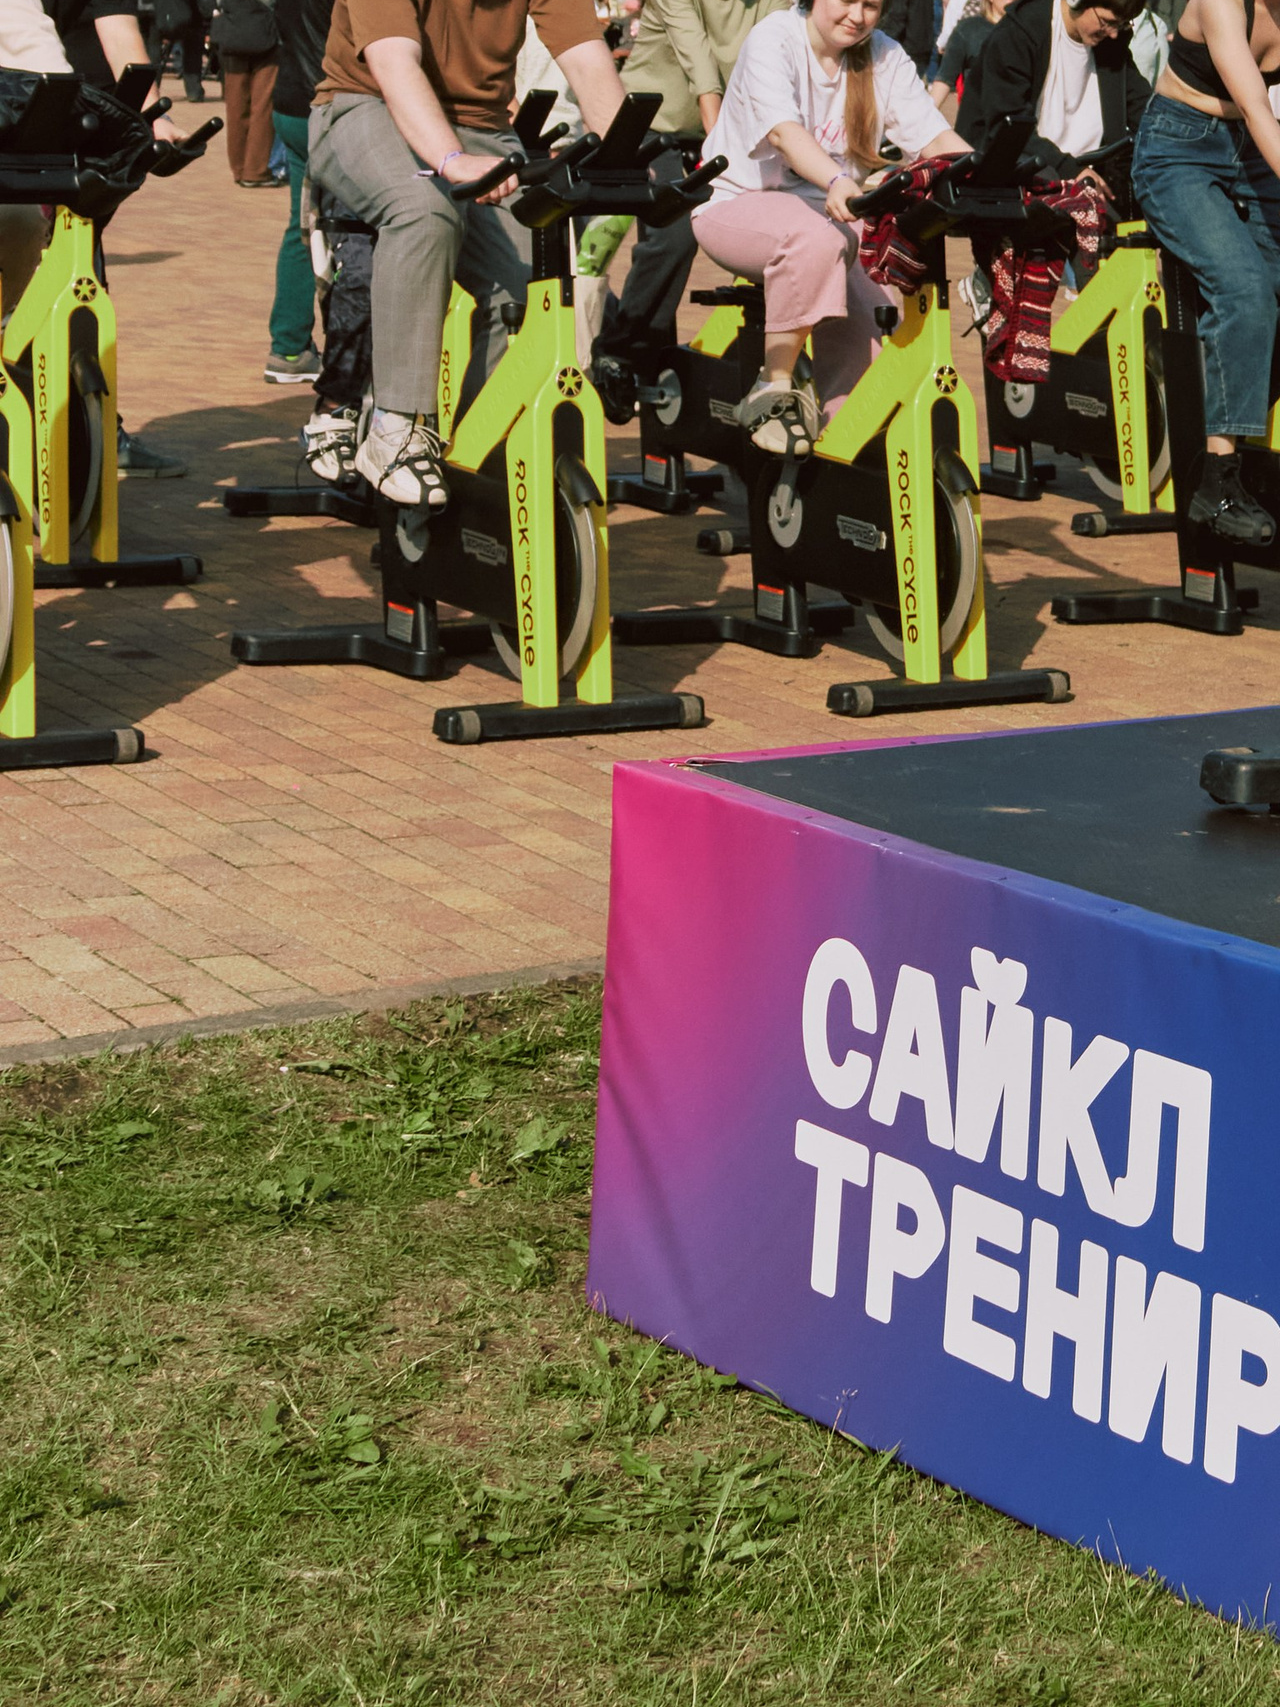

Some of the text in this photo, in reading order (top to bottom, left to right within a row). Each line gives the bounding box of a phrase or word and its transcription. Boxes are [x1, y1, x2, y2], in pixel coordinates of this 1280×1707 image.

[543, 290, 551, 312] 6
[919, 294, 927, 315] 8
[38, 352, 48, 426] ROCK
[441, 349, 451, 417] ROCK
[1117, 344, 1129, 404] ROCK
[515, 459, 529, 548] ROCK
[897, 449, 912, 532] ROCK
[803, 937, 1212, 1252] САЙКЛ
